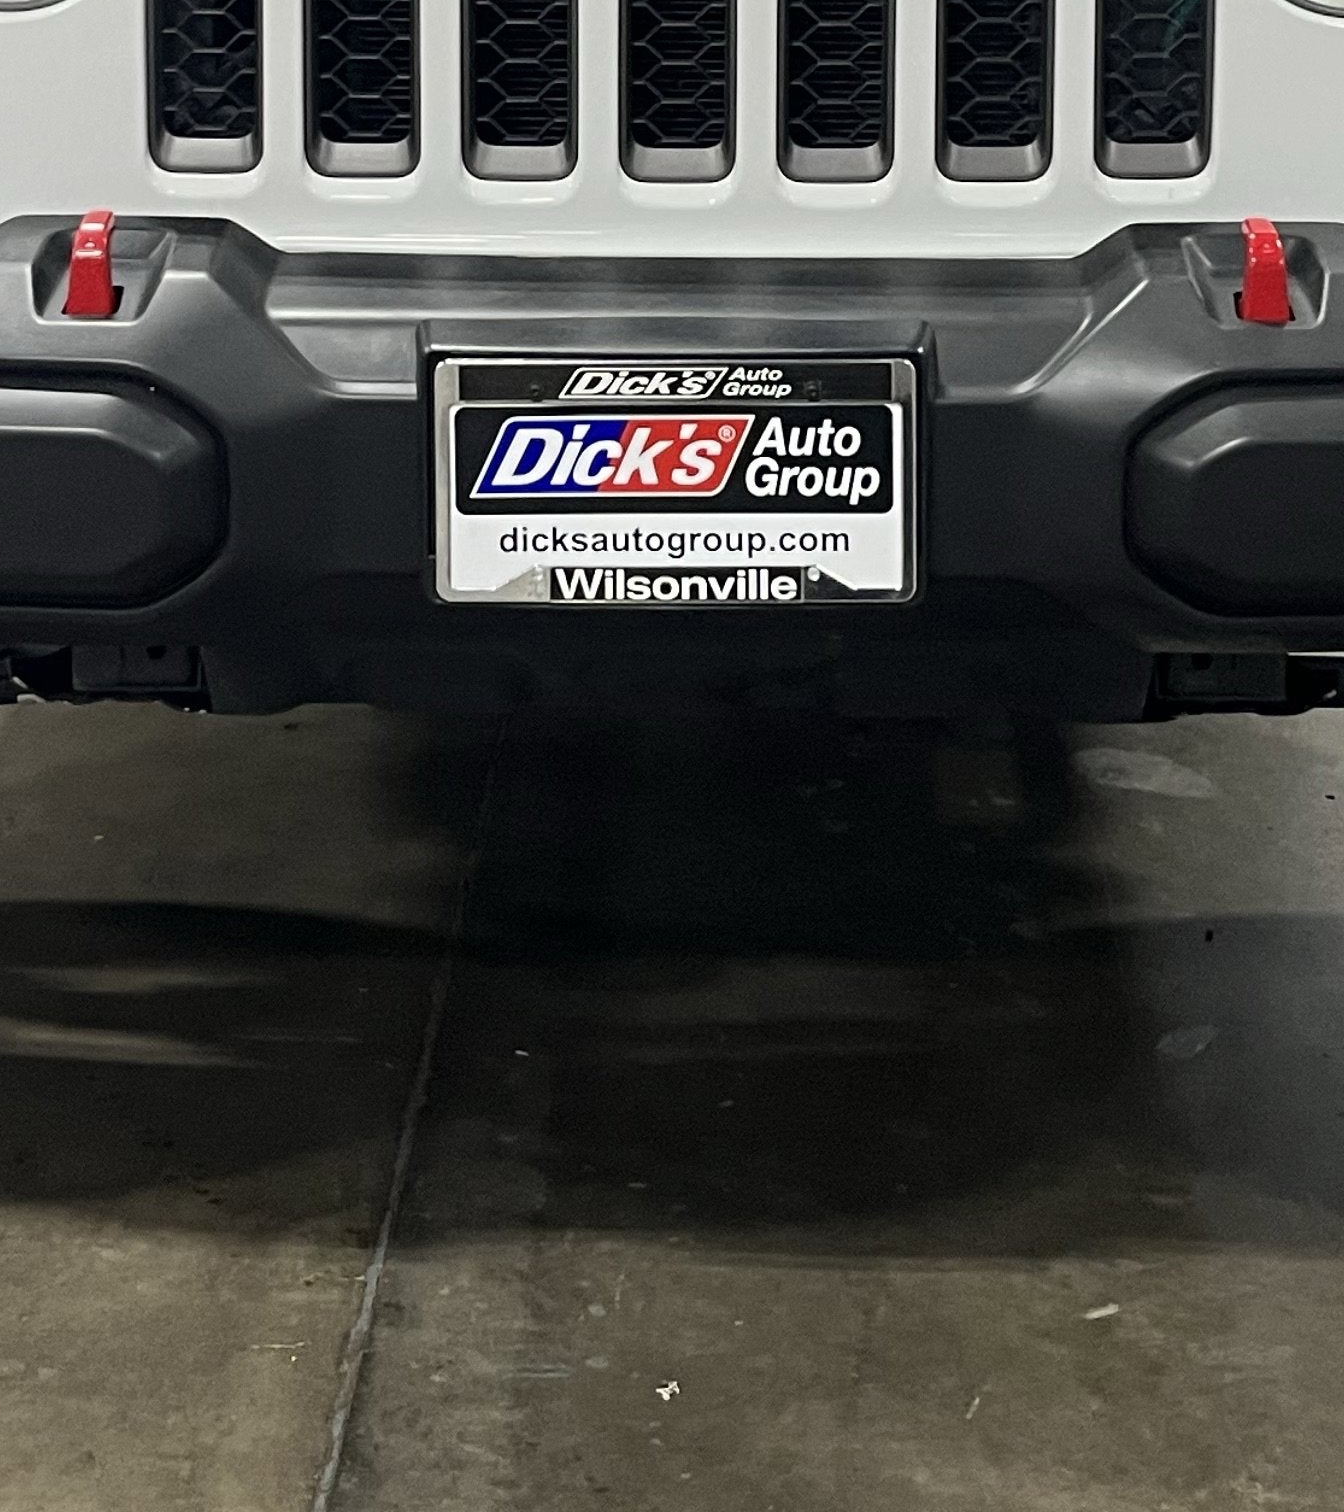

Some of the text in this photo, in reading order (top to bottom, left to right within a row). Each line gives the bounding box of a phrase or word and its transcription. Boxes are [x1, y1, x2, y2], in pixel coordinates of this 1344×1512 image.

[727, 367, 783, 381] Auto
[722, 382, 792, 399] Group
[752, 417, 861, 457] Auto
[744, 458, 881, 505] Group
[499, 526, 850, 558] dicksautogroup.com
[555, 568, 798, 601] Wilsonville
